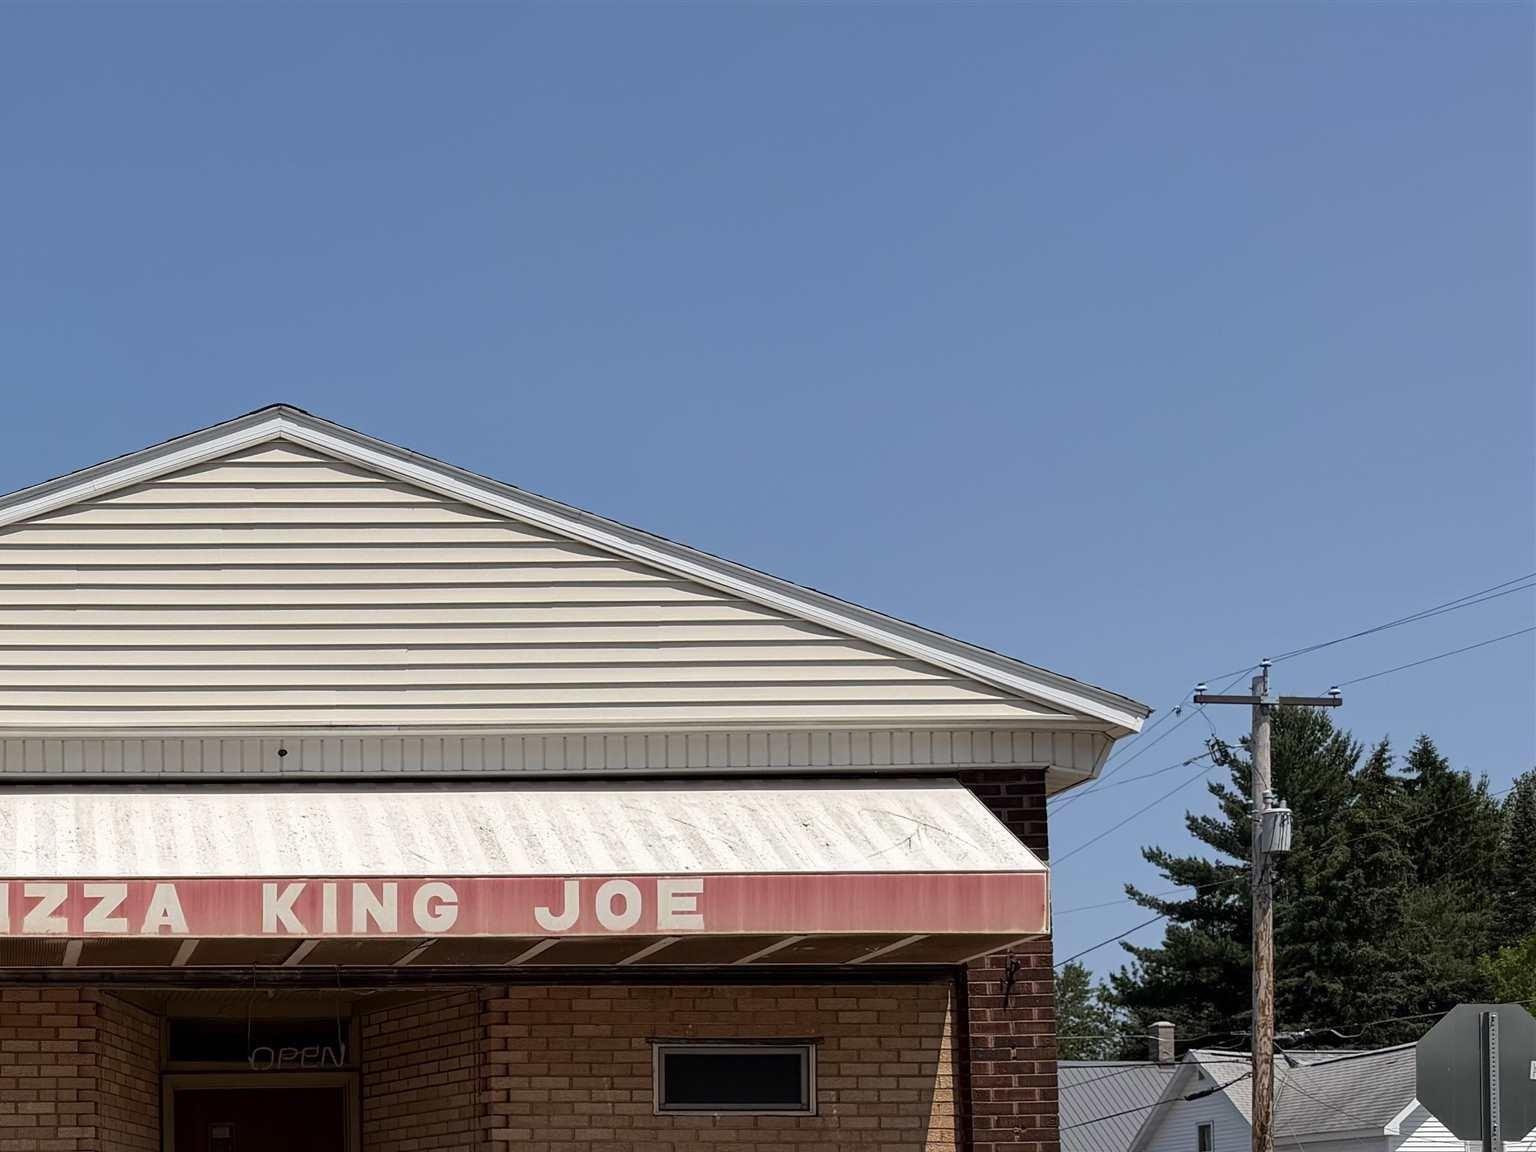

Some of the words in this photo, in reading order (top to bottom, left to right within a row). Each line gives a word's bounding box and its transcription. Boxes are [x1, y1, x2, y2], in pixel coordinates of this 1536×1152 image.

[262, 882, 458, 933] KING
[534, 878, 705, 931] JOE
[249, 1044, 345, 1070] OPEN
